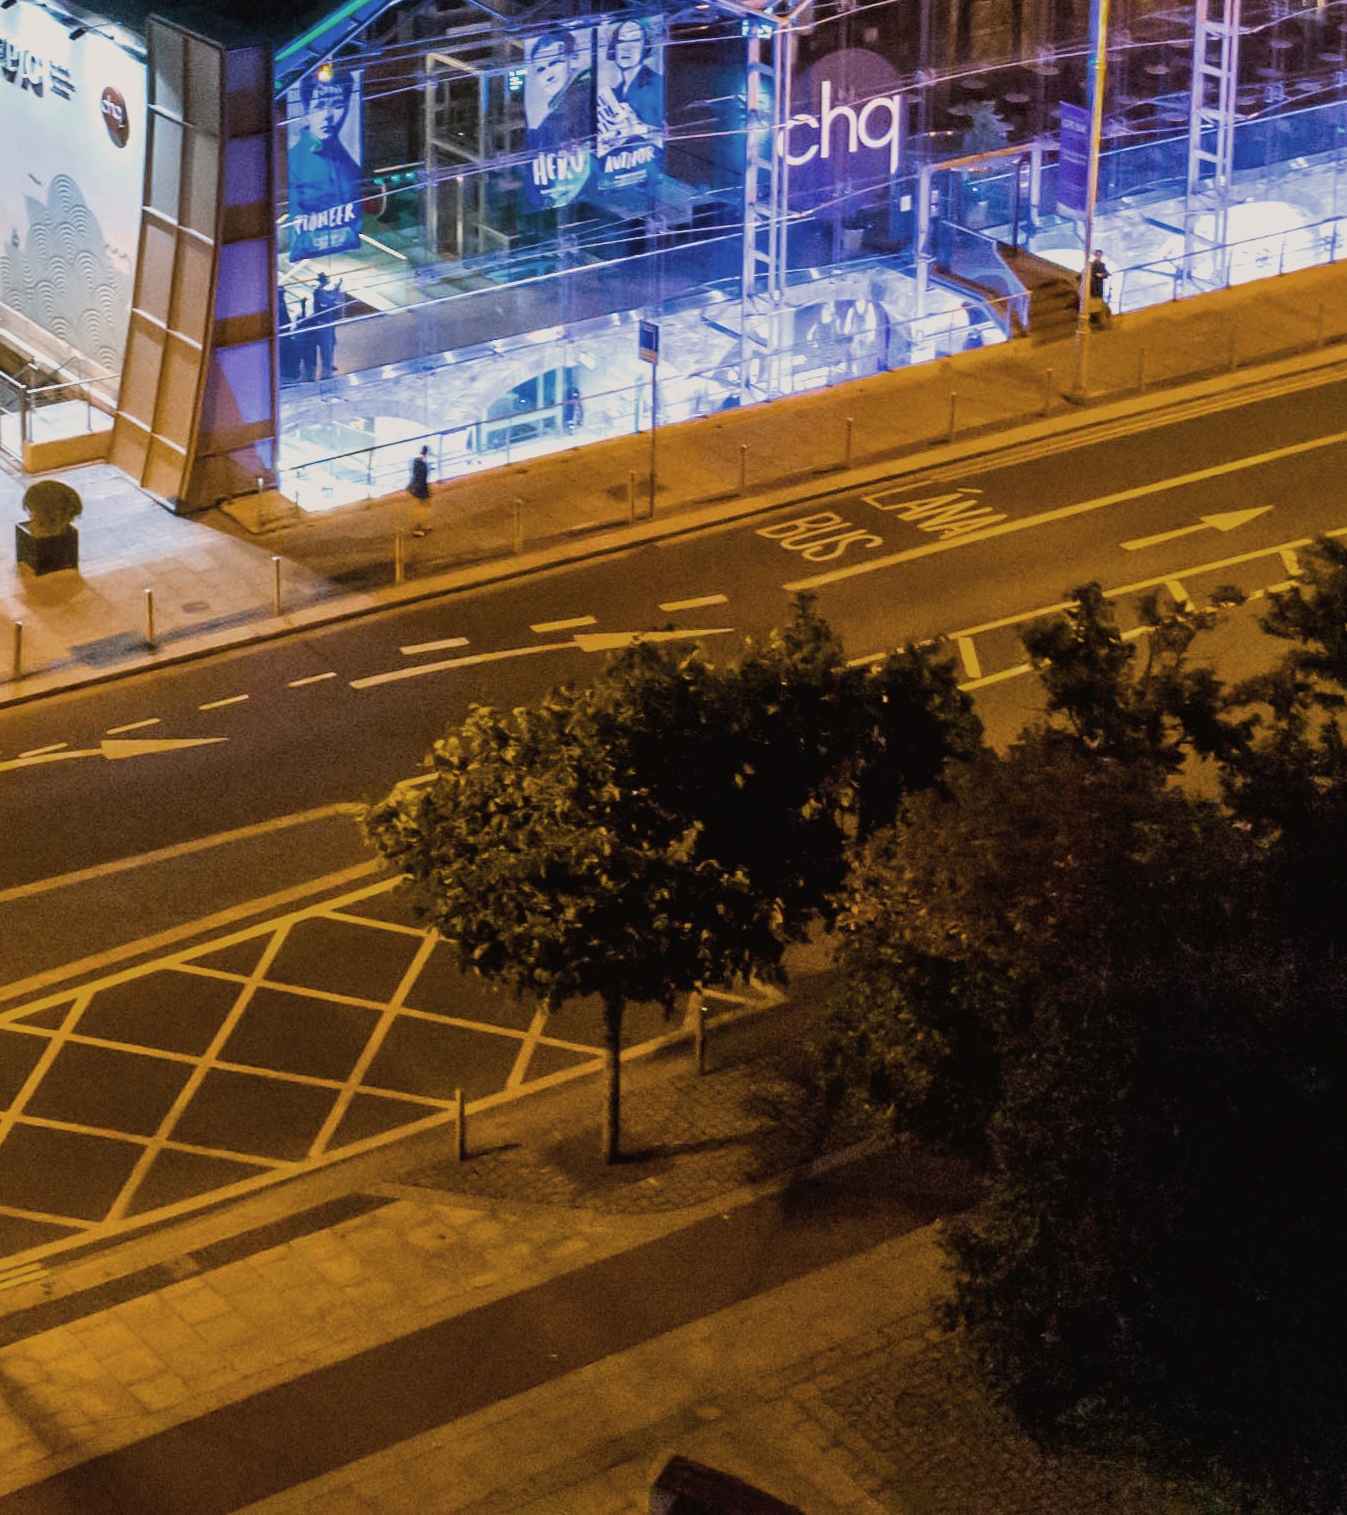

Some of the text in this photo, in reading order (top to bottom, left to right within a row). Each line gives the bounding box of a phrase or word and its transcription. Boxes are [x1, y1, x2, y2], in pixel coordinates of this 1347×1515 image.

[777, 80, 902, 175] chq
[532, 147, 586, 186] HERO
[756, 511, 883, 562] BUS
[860, 487, 1008, 540] LÁNA
